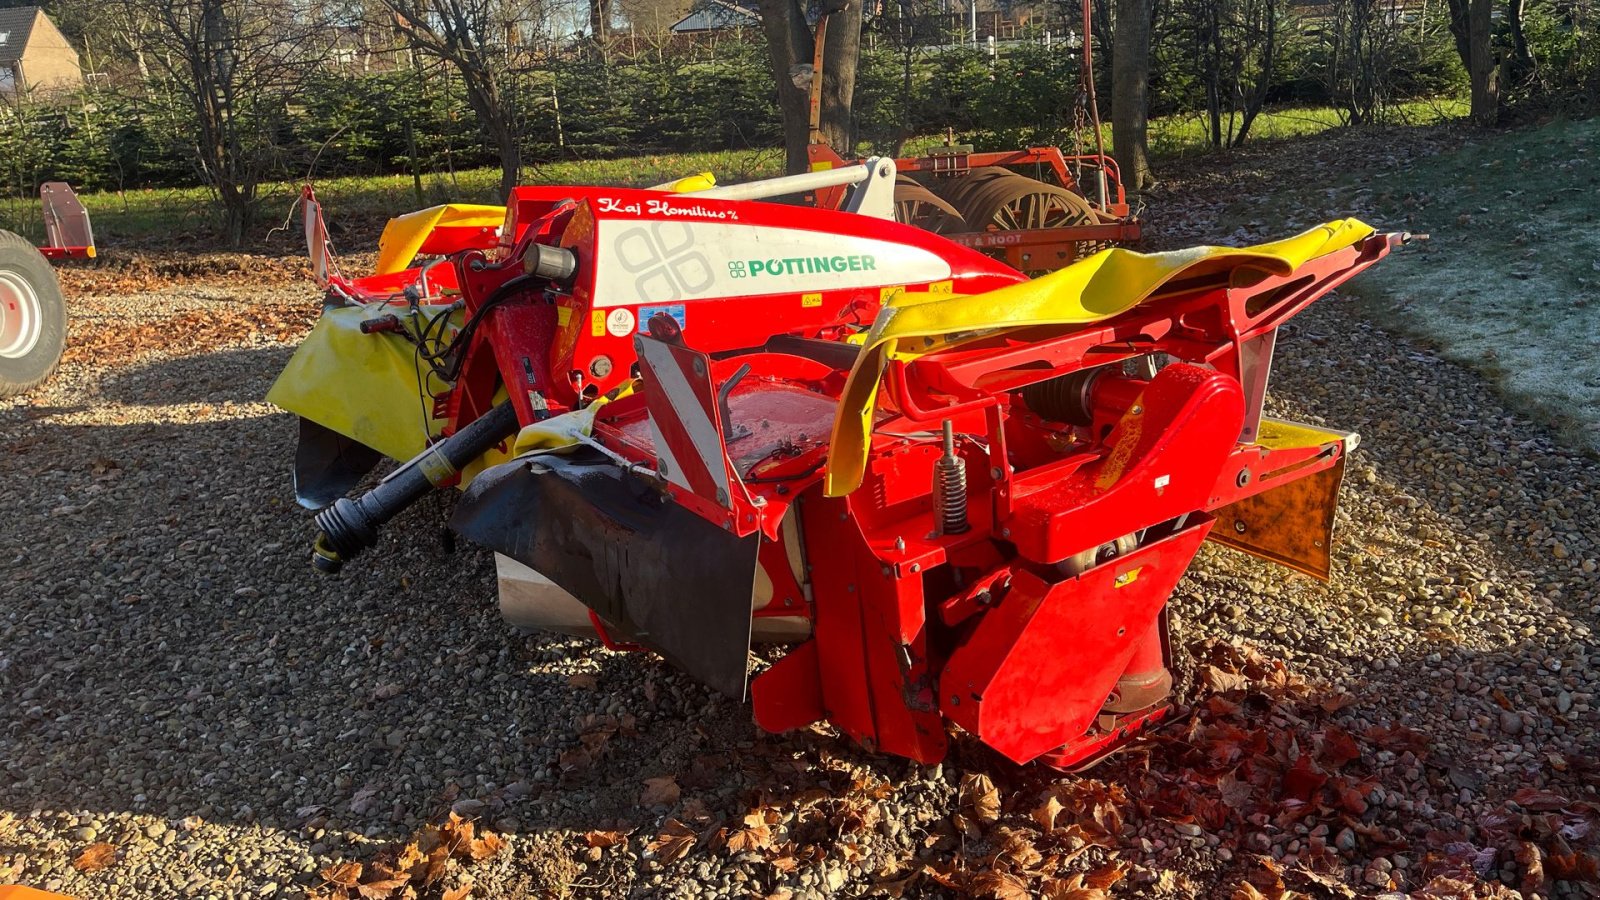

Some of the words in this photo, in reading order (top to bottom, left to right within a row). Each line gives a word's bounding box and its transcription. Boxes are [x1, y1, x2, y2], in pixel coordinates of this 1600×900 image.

[597, 198, 641, 215] Kaj
[646, 200, 726, 218] Homilius
[988, 235, 1021, 246] NOOT
[748, 255, 876, 277] PÖTTINGER
